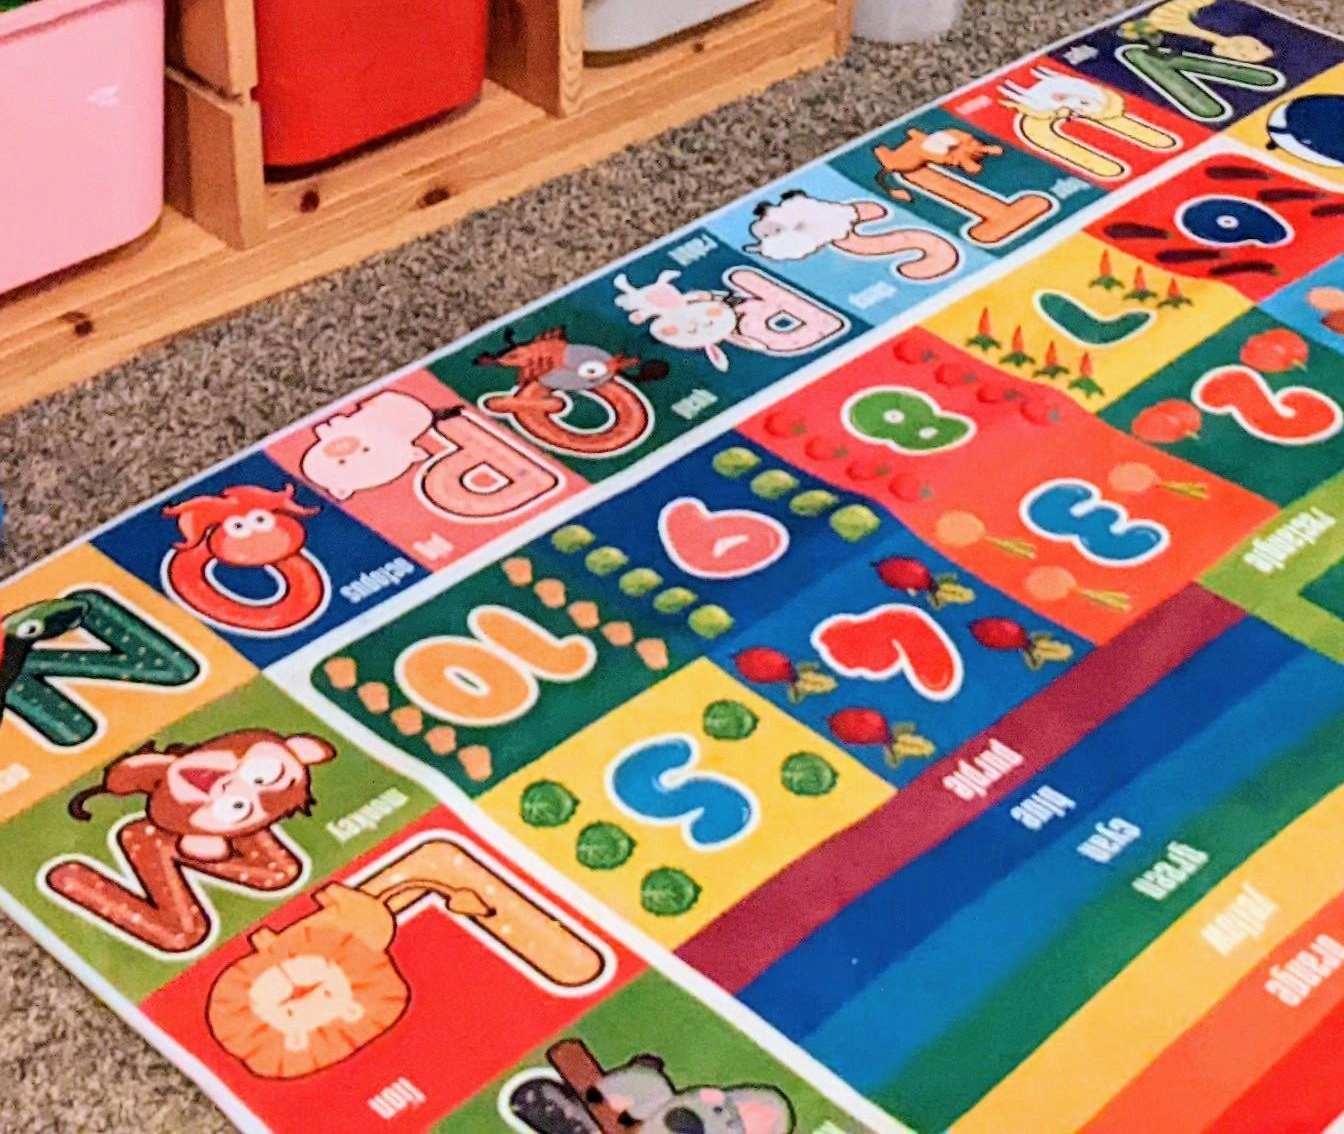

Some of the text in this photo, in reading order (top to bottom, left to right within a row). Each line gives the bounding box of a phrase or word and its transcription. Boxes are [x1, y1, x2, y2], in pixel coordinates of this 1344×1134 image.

[1115, 44, 1286, 122] V
[1013, 112, 1183, 182] U
[831, 200, 965, 285] S
[891, 162, 1059, 249] T
[1174, 194, 1294, 247] 6
[721, 264, 853, 358] R
[1032, 289, 1157, 350] 7
[477, 373, 656, 459] Q
[840, 385, 977, 454] 8
[413, 406, 576, 524] P
[657, 496, 790, 579] 9
[1019, 476, 1171, 567] 3
[160, 530, 333, 643] O
[339, 556, 416, 604] octopus
[6, 582, 209, 755] N
[394, 604, 598, 728] 10
[810, 602, 964, 702] 4
[604, 732, 762, 852] 5
[942, 737, 1025, 801] purple
[1009, 784, 1078, 832] blue
[325, 786, 409, 845] monkey
[1076, 816, 1143, 865] cyan
[35, 810, 312, 964] M
[1131, 840, 1211, 902] green
[346, 828, 619, 1000] L
[1199, 882, 1280, 958] yellow
[367, 1076, 428, 1120] lion
